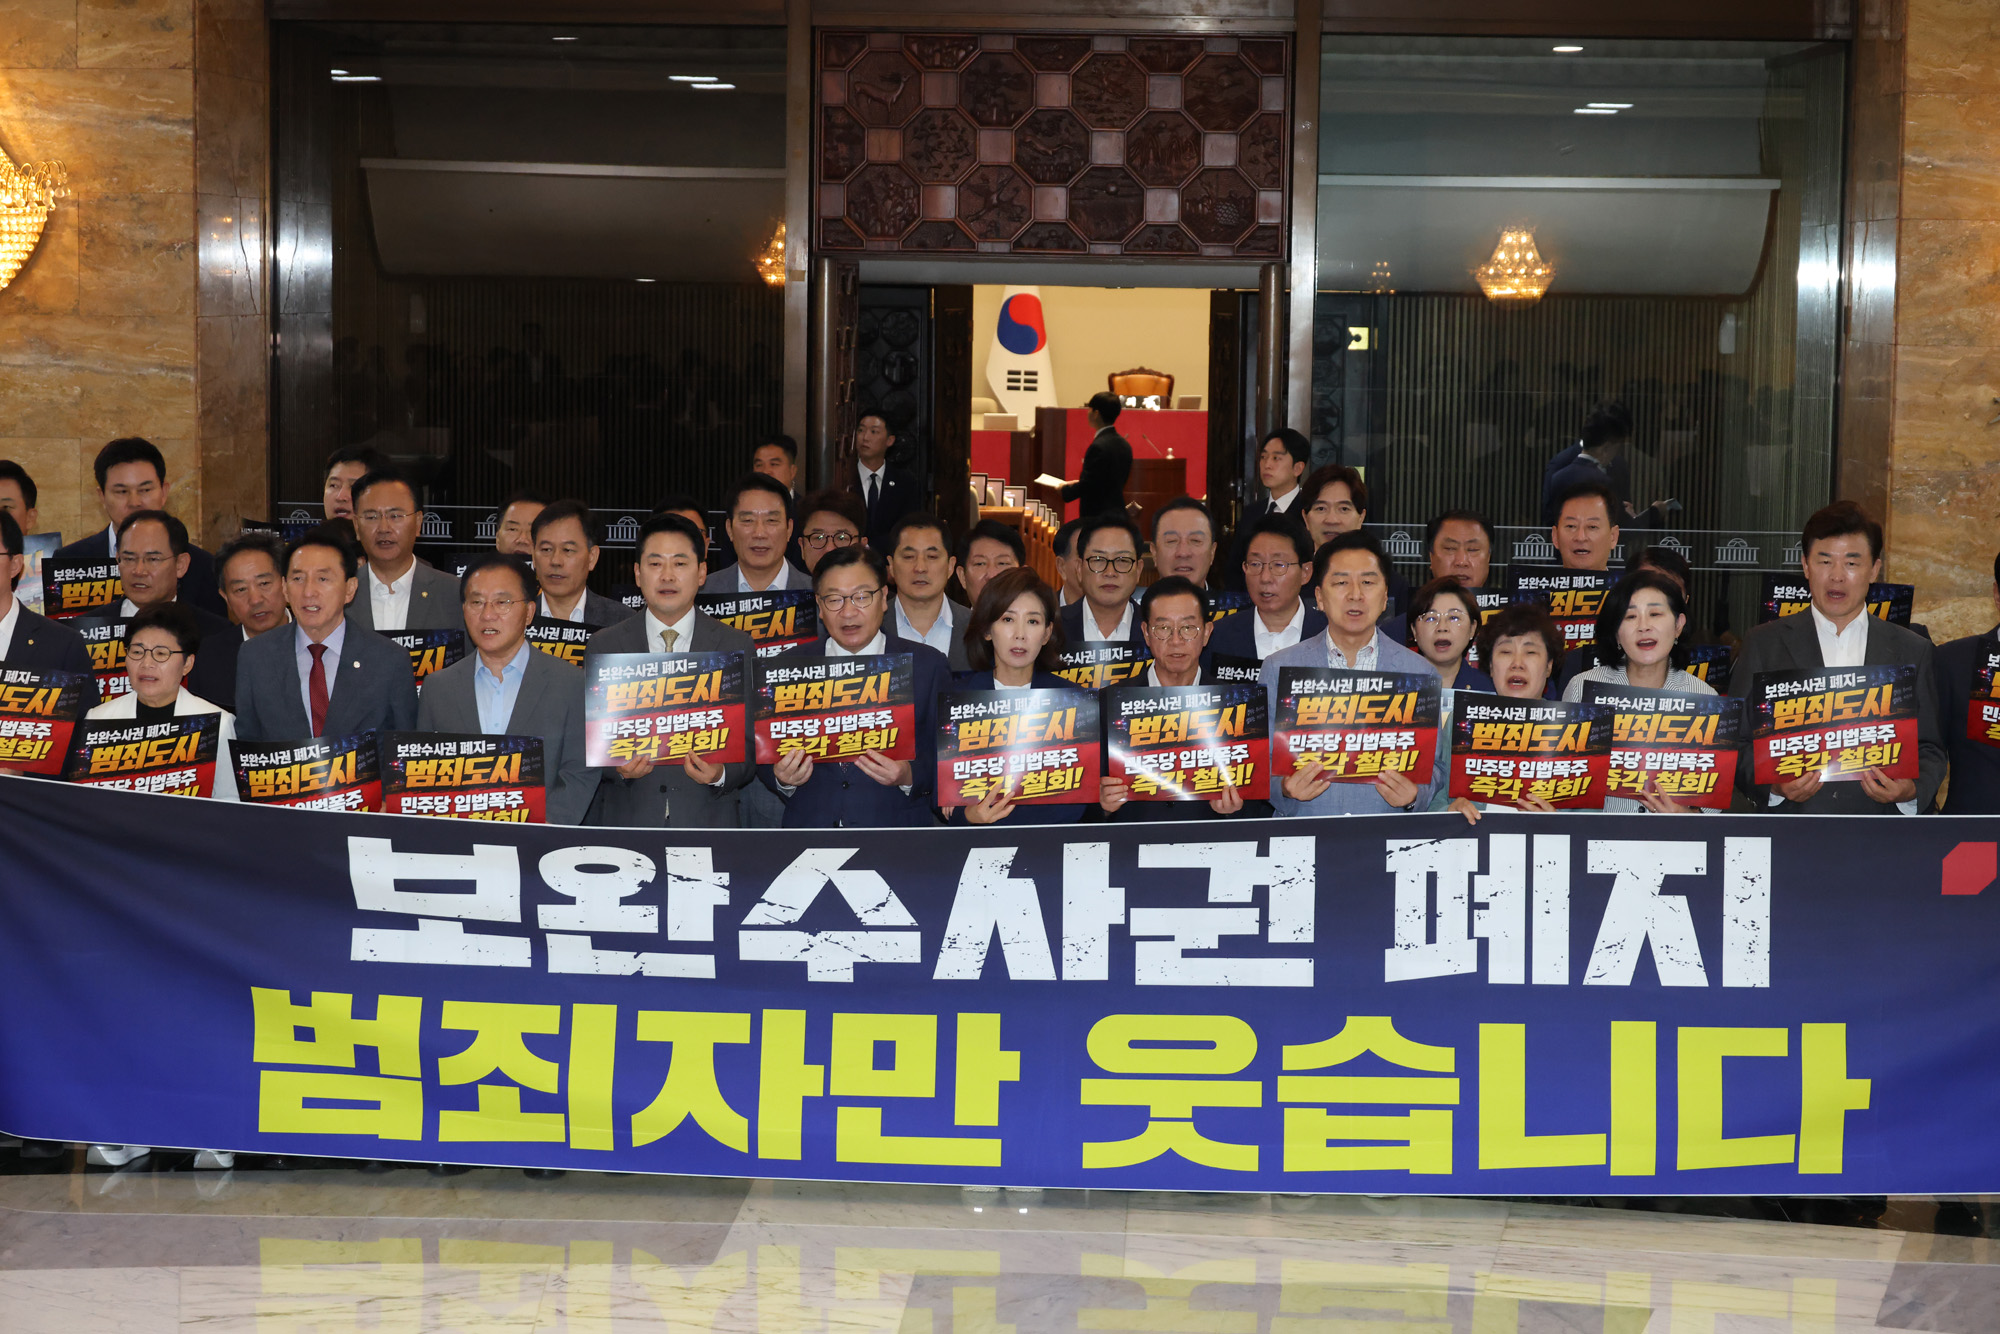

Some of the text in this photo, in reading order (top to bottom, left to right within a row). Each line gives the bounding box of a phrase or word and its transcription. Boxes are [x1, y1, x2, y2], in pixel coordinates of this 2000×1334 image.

[54, 566, 107, 581] 보완수사권
[1518, 576, 1604, 589] 보완수사권 폐지=
[62, 579, 124, 608] 범죄
[739, 597, 772, 613] 폐지=
[1773, 585, 1812, 599] 보완수
[524, 626, 560, 640] 수사권
[1060, 647, 1133, 666] 수사권 폐지=
[4, 670, 40, 685] 폐지=
[598, 659, 697, 681] 보완수사권 폐지=
[765, 662, 865, 684] 보완수사권 폐지=
[606, 669, 724, 713] 범죄도시
[774, 672, 892, 713] 범죄도시
[1291, 677, 1393, 695] 보완수사권 폐지=
[1765, 673, 1866, 699] 보완수사권 폐지=
[950, 694, 1051, 721] 보완수사권 폐지=
[1120, 692, 1221, 715] 보완수사권 폐지=
[1296, 691, 1418, 726] 범죄도시
[1466, 705, 1567, 722] 보완수사권 폐지=
[1658, 698, 1695, 712] 폐지=
[1773, 684, 1895, 730] 범죄도시
[0, 720, 52, 739] 법폭주
[86, 722, 179, 745] 보완수사권 폐지=
[601, 709, 724, 740] 민주당 입법폭주
[770, 710, 893, 739] 민주당 입법폭주
[958, 707, 1078, 752] 범죄도시
[1129, 704, 1248, 748] 범죄도시
[1471, 721, 1592, 753] 범죄도시
[89, 729, 201, 775] 범죄도시
[397, 740, 496, 758] 보완수사권 폐지=
[607, 727, 729, 760] 즉각 철회!
[836, 727, 899, 754] 철회!
[1288, 731, 1415, 752] 민주당 입법폭주
[1769, 723, 1896, 758] 민주당 입법폭주
[240, 744, 330, 768] 보완수사권 폐지=
[953, 747, 1078, 780] 민주당 입법폭주
[1124, 743, 1249, 775] 민주당 입법폭주
[1353, 750, 1419, 774] 철회!
[1464, 758, 1588, 779] 민주당 입법폭주
[1609, 750, 1715, 772] 주당 입법폭주
[1775, 742, 1902, 778] 즉각 철회!
[248, 751, 358, 798] 범죄도시
[405, 752, 521, 789] 범죄도시
[1020, 767, 1083, 796] 철회!
[1130, 763, 1254, 796] 즉각 철회!
[1654, 770, 1719, 794] 철회!
[400, 790, 524, 814] 민주당 입법폭주
[1469, 776, 1593, 802] 즉각 철회!
[347, 833, 1772, 988] 보완수사권 폐지
[251, 985, 1872, 1176] 범죄자만 웃습니다
